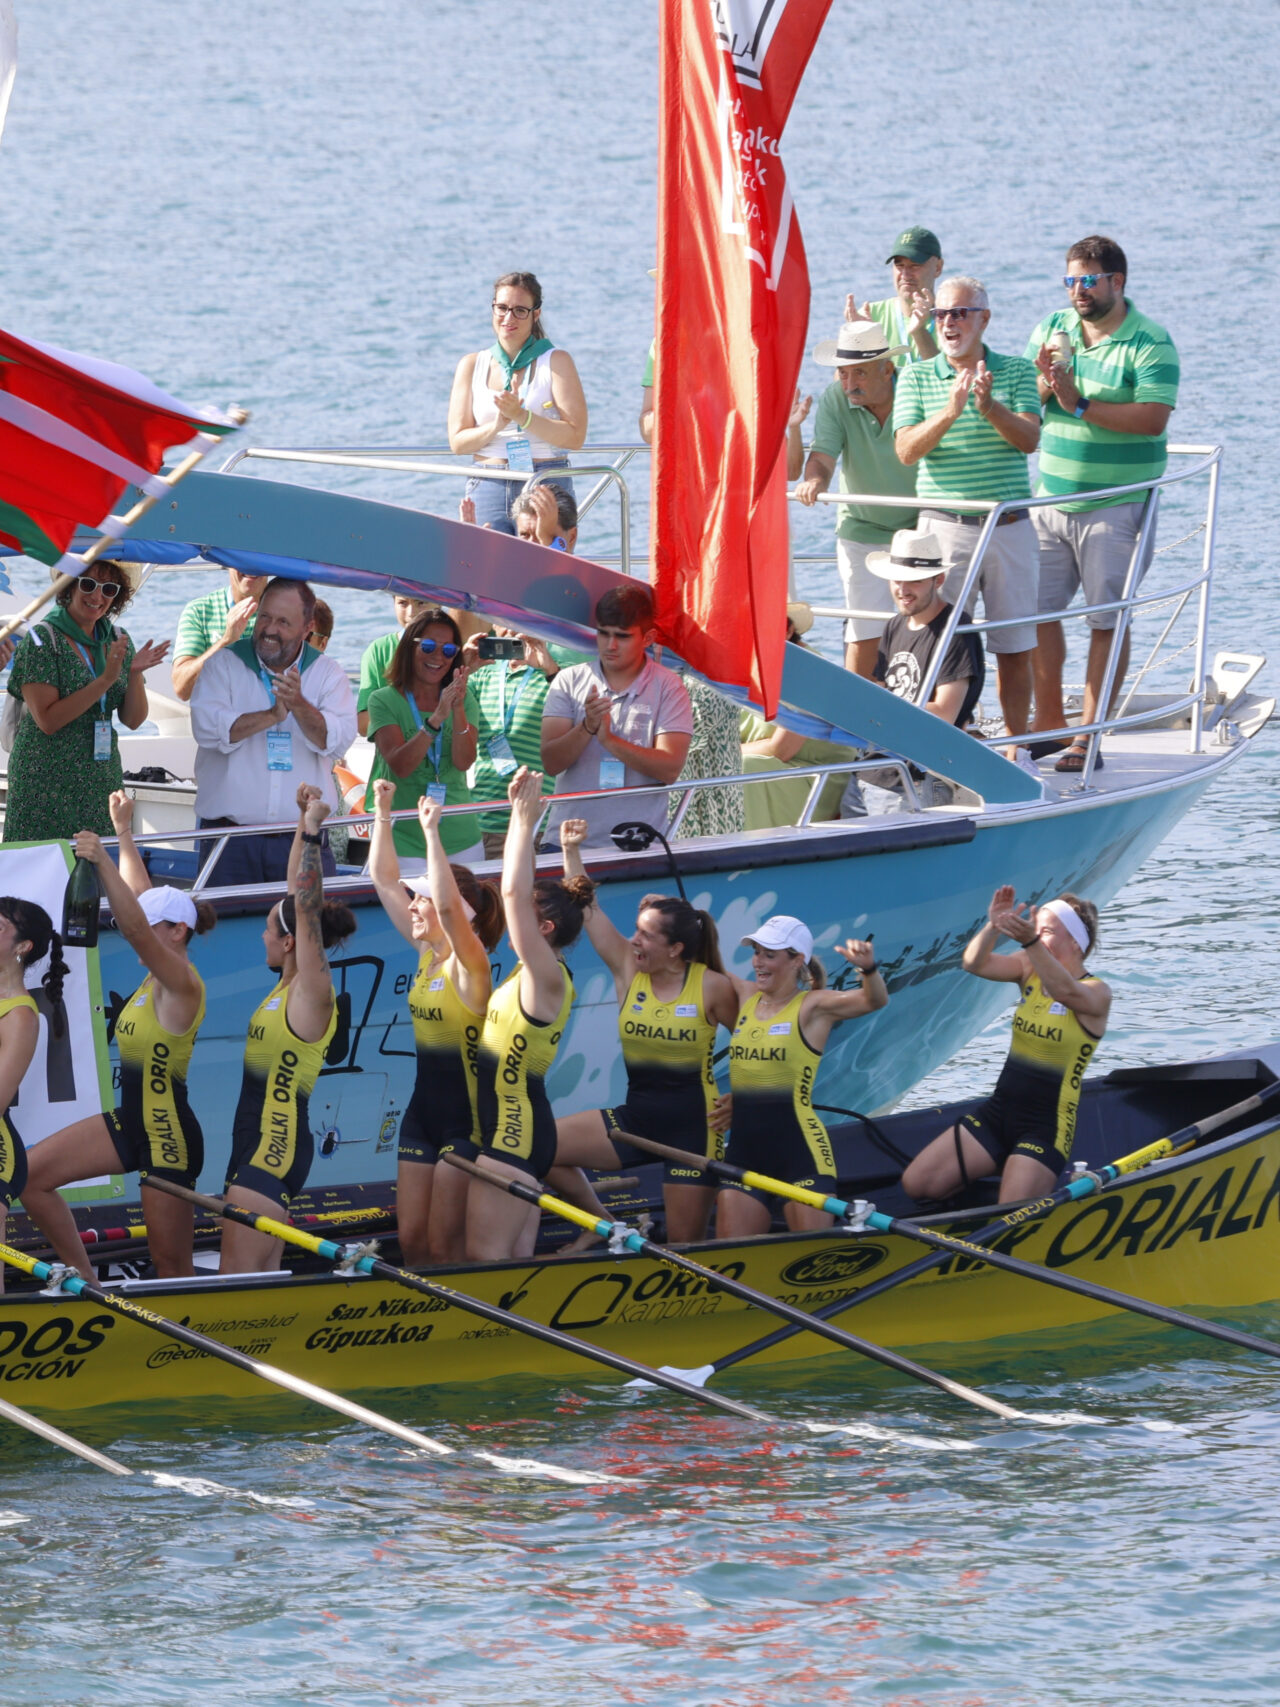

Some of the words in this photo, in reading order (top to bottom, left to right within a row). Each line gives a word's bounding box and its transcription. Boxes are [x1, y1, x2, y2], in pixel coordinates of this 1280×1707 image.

[410, 1007, 443, 1022] RIALKI
[624, 1020, 697, 1042] ORIALKI
[151, 1043, 170, 1095] ORIO
[503, 1033, 527, 1085] ORIO
[729, 1046, 786, 1061] ORIALKI
[1071, 1043, 1093, 1090] ORIO
[272, 1050, 298, 1103] ORIO
[800, 1066, 813, 1107] ORIO
[152, 1108, 180, 1164] ORIALKI
[264, 1112, 289, 1168] ORIALKI
[806, 1118, 834, 1168] ORIALKI
[670, 1168, 701, 1178] ORIO
[795, 1250, 864, 1280] Ford
[325, 1303, 368, 1322] San
[370, 1295, 452, 1318] Nikolas
[615, 1295, 723, 1325] kanpina
[305, 1322, 435, 1353] Gipuzkoa
